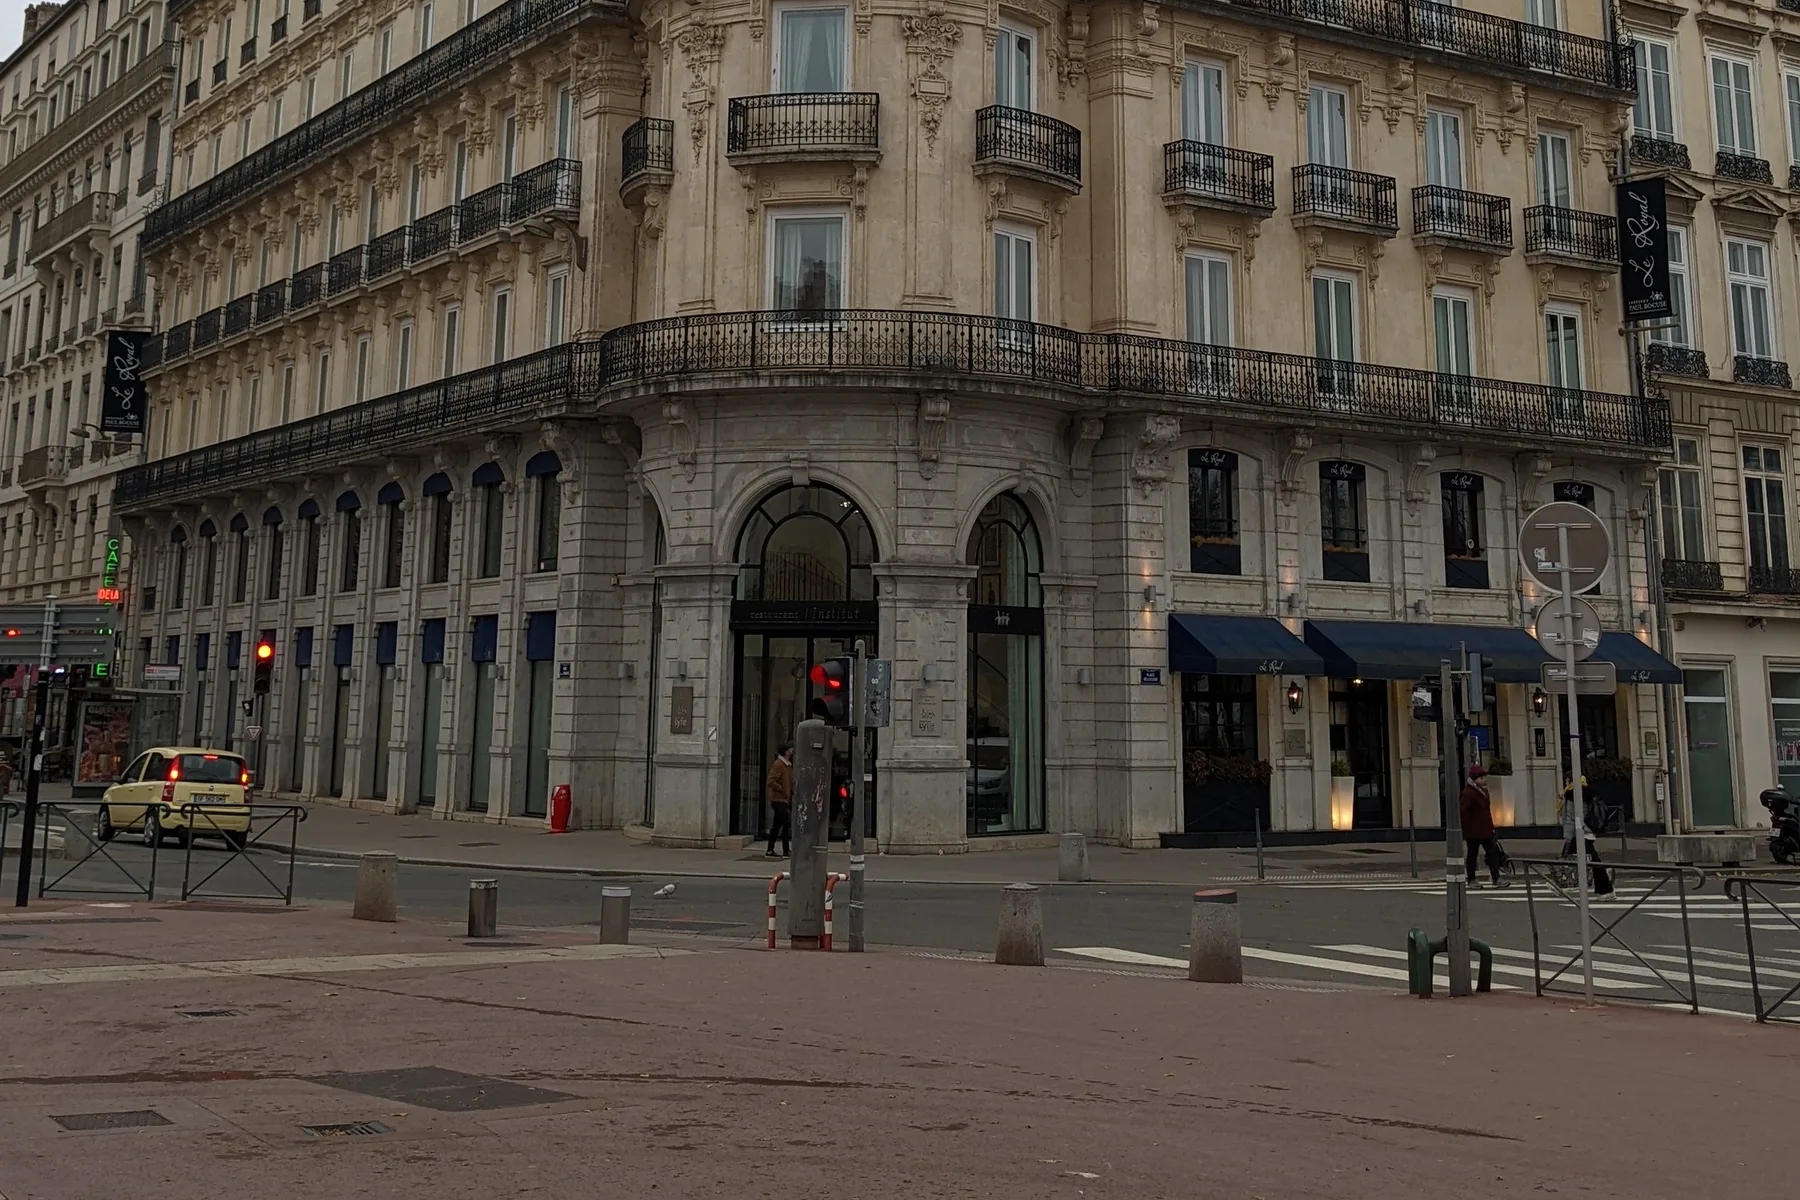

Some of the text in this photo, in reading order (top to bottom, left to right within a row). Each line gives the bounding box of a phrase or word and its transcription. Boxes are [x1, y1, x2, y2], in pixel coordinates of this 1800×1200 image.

[1626, 191, 1660, 288] Le Royal
[1628, 304, 1644, 312] PAUL
[111, 336, 141, 411] Le Royal
[749, 610, 799, 619] restaurant
